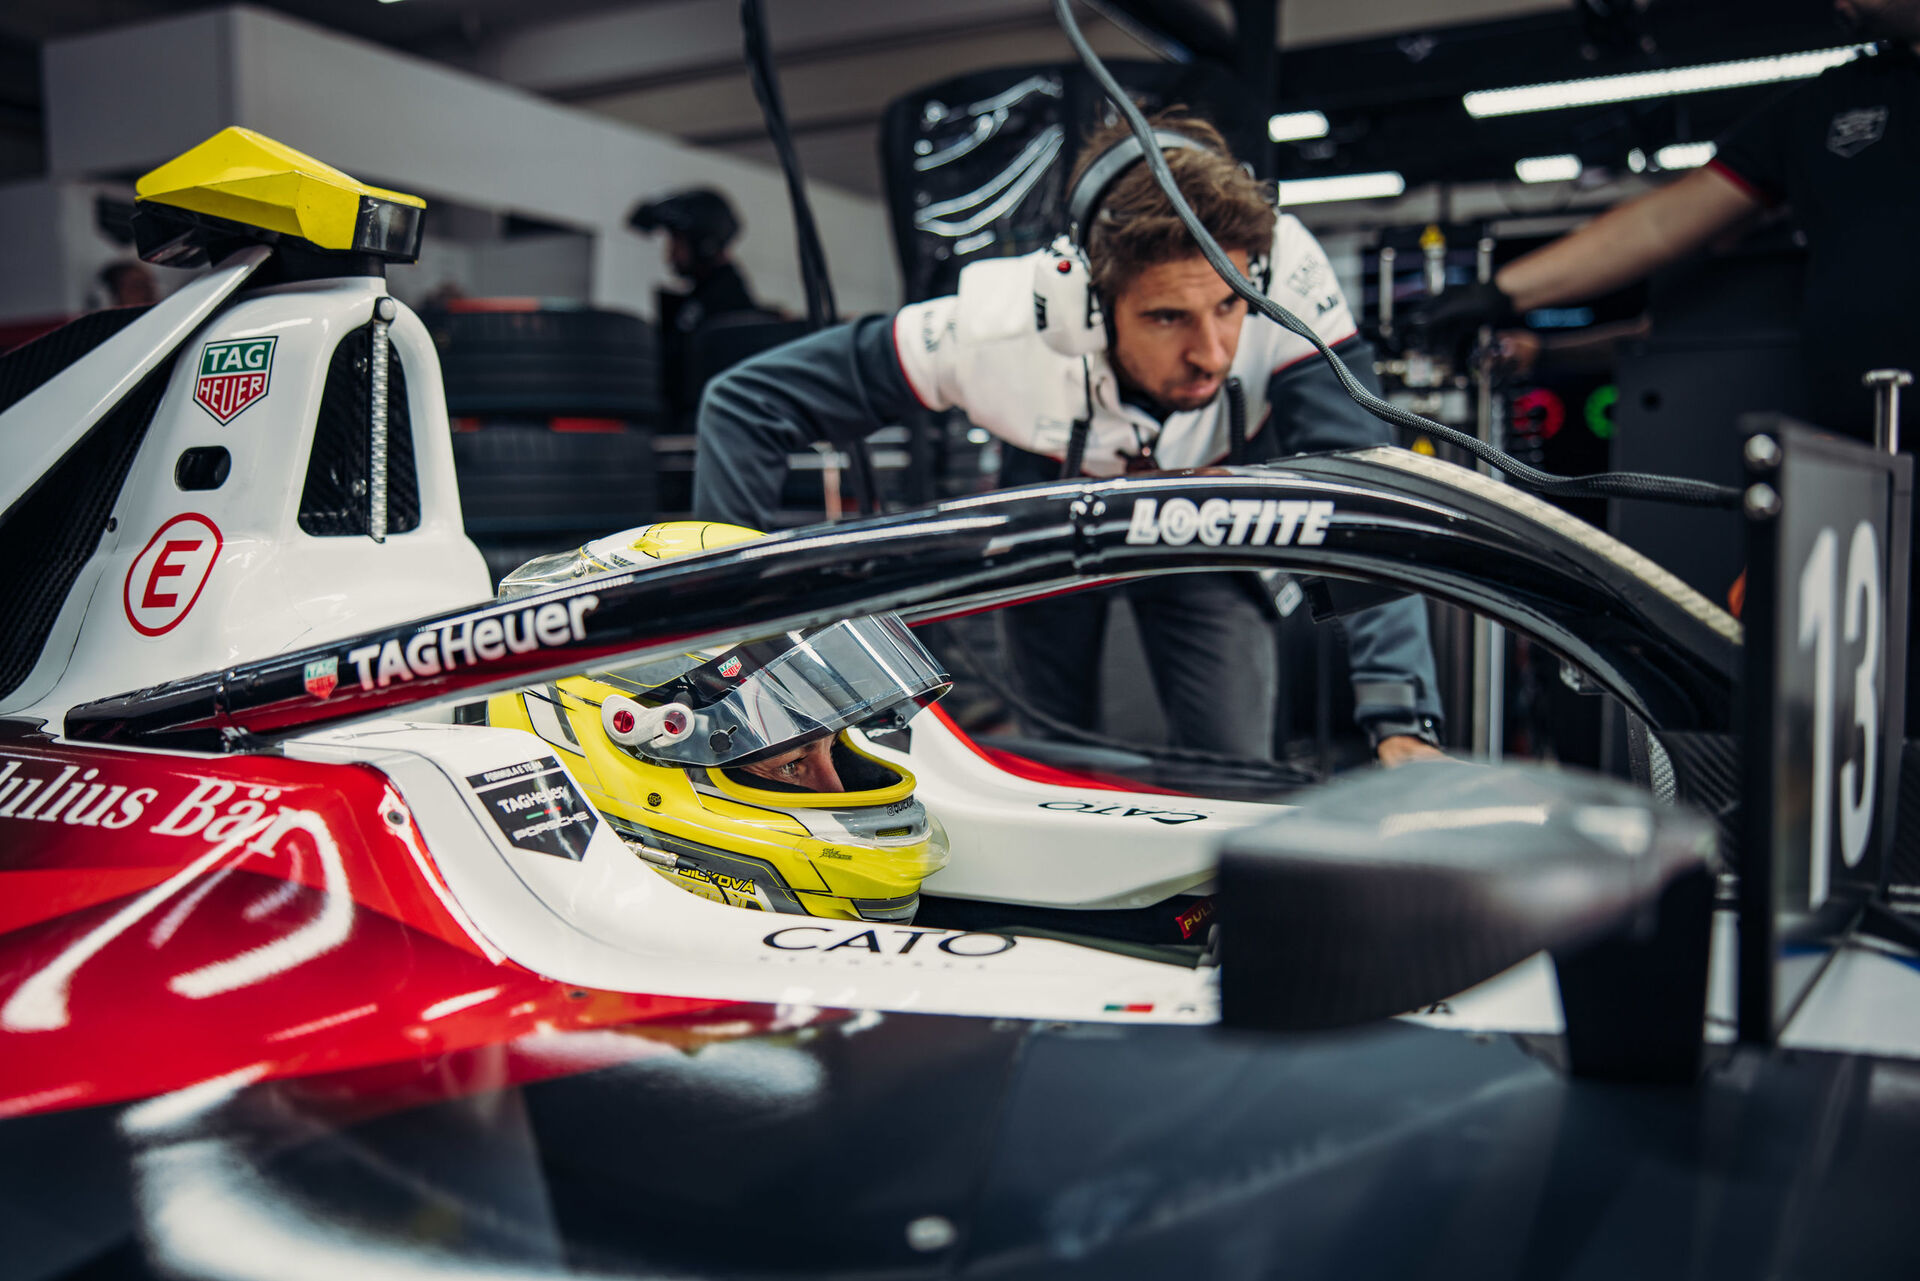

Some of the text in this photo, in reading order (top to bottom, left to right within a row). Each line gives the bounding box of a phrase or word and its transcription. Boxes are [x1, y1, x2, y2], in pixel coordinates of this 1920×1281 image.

[208, 344, 265, 371] TAG
[199, 376, 263, 416] HEUER
[1126, 498, 1334, 545] LOCTITE
[142, 540, 203, 608] E
[1798, 520, 1881, 912] 13
[150, 777, 298, 857] Bär
[512, 811, 590, 840] PORSCHE
[1038, 801, 1208, 825] CATO
[763, 926, 1017, 957] CATO
